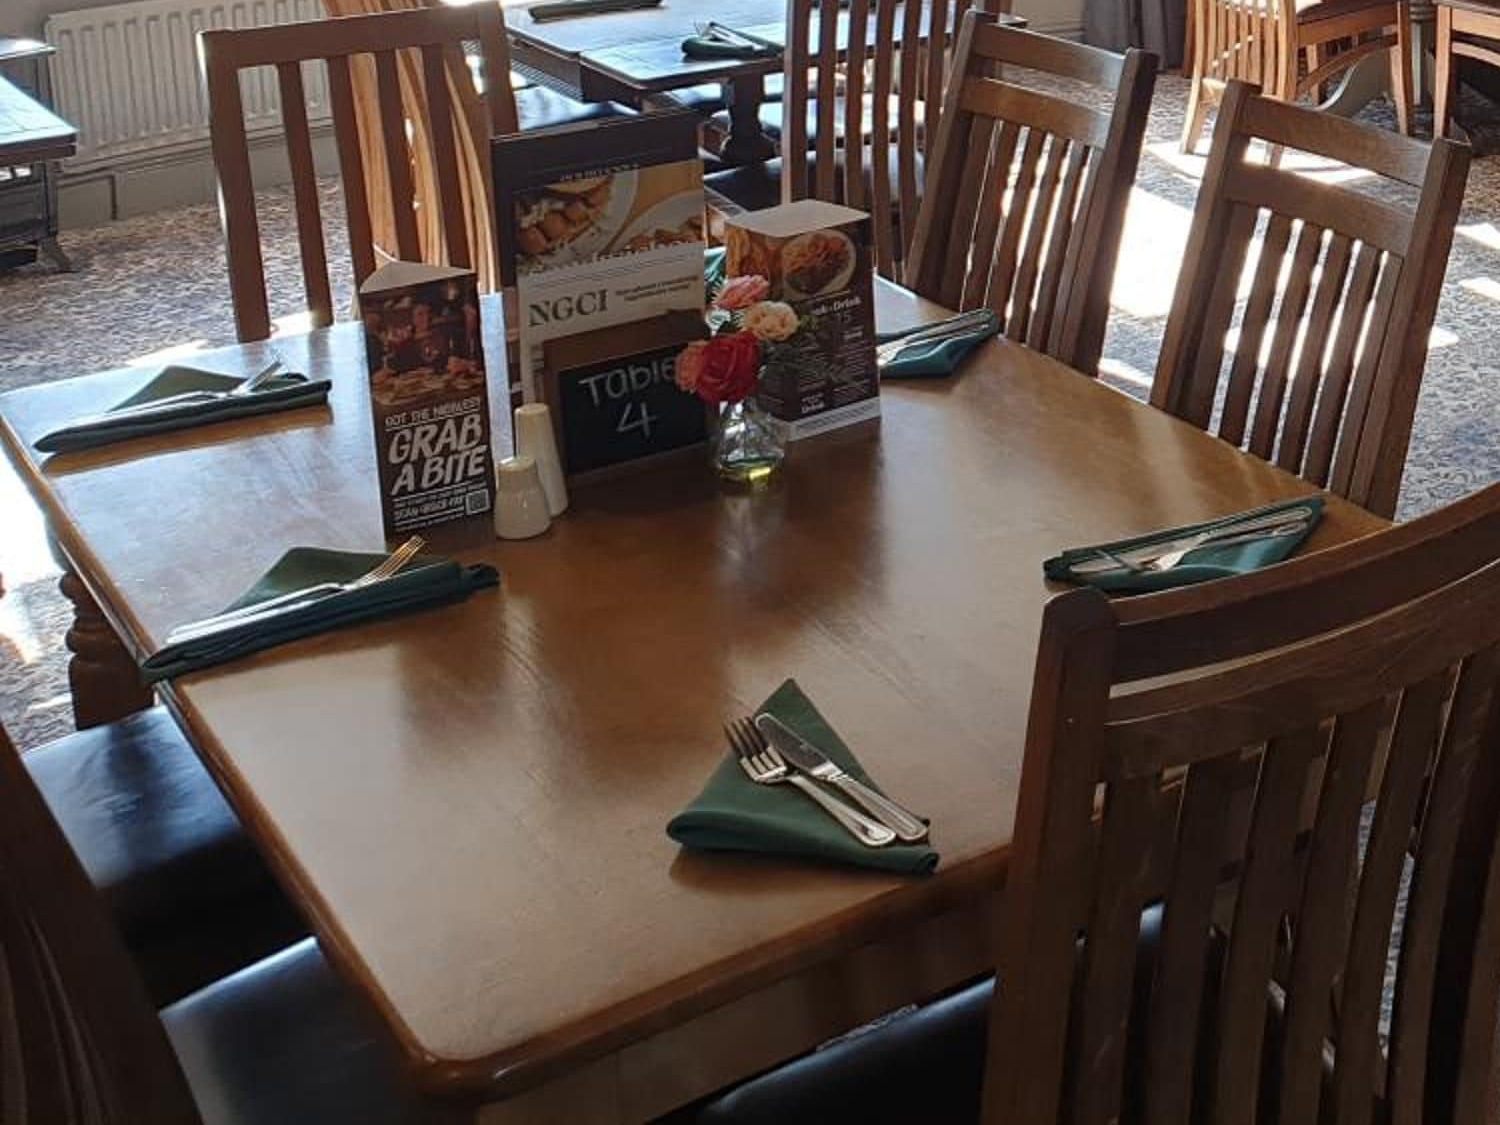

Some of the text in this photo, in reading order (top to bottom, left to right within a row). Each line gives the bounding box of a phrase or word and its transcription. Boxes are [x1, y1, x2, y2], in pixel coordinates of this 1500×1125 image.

[528, 288, 609, 328] NGCI
[577, 356, 677, 407] Table
[388, 414, 483, 464] GRAB
[615, 401, 657, 439] 4
[391, 463, 415, 496] A
[421, 445, 489, 489] BITE
